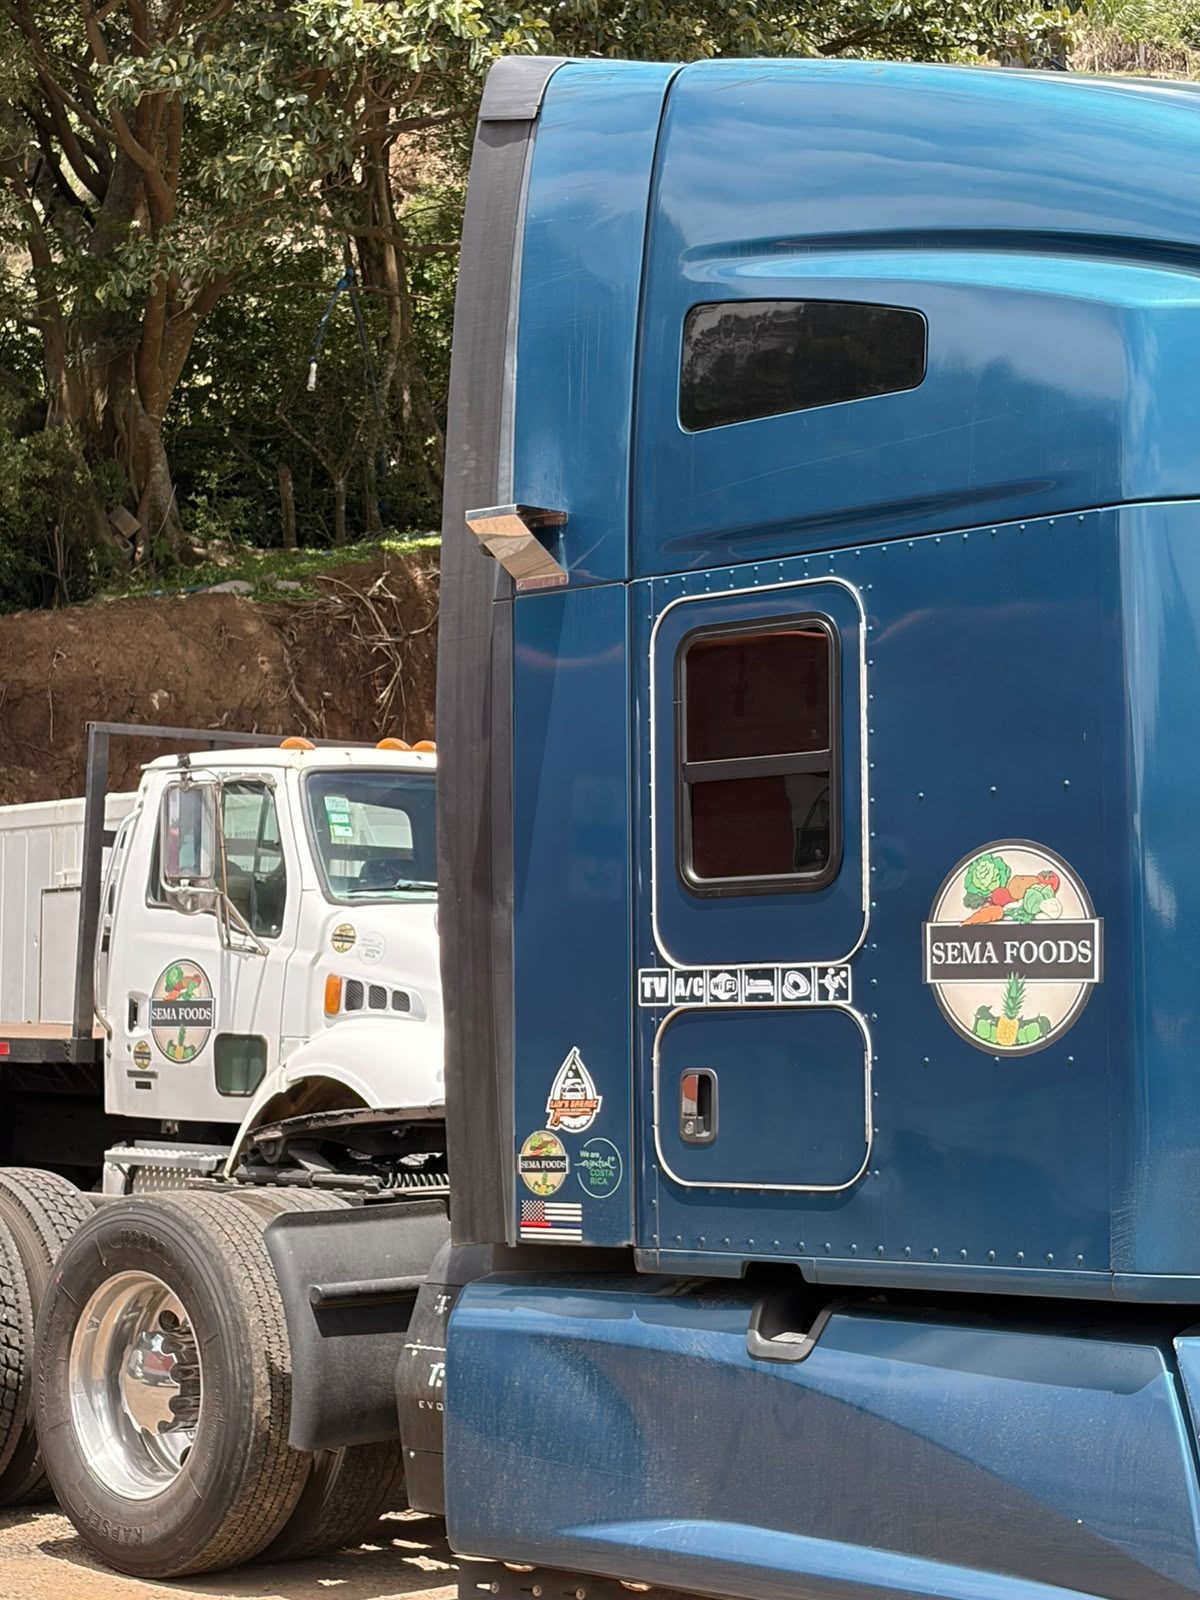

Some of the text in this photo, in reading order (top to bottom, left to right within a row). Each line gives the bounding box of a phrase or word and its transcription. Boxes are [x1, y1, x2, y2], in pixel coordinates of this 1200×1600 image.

[932, 940, 1092, 965] SEMA FOODS
[641, 976, 667, 998] TV
[674, 977, 704, 997] A/C
[151, 1007, 212, 1020] SEMA FOODS
[521, 1159, 567, 1169] SEMA FOODS
[589, 1169, 614, 1178] COSTA
[589, 1177, 608, 1185] RICA
